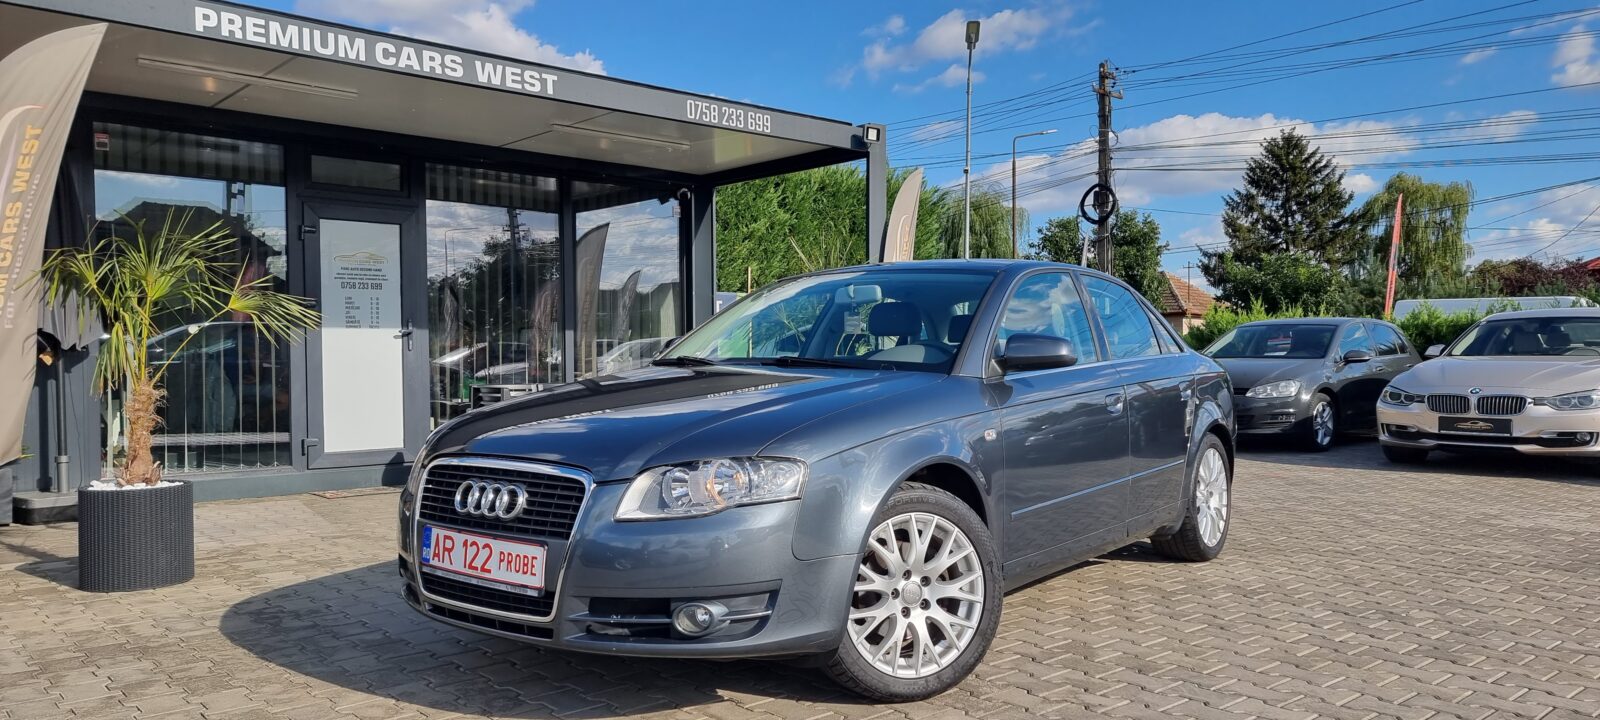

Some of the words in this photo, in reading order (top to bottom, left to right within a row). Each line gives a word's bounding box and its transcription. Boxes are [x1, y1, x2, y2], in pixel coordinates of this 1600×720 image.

[194, 6, 366, 62] PREMIUM
[375, 41, 464, 78] CARS
[475, 60, 558, 95] WEST
[687, 99, 718, 123] 0758
[722, 106, 744, 128] 233
[748, 112, 771, 133] 699
[11, 124, 43, 194] WEST
[0, 201, 23, 267] CARS
[341, 281, 357, 290] 0758
[358, 282, 369, 290] 233
[370, 282, 383, 291] 699
[432, 533, 455, 565] AR
[462, 539, 493, 574] 122
[498, 550, 538, 577] PROBE
